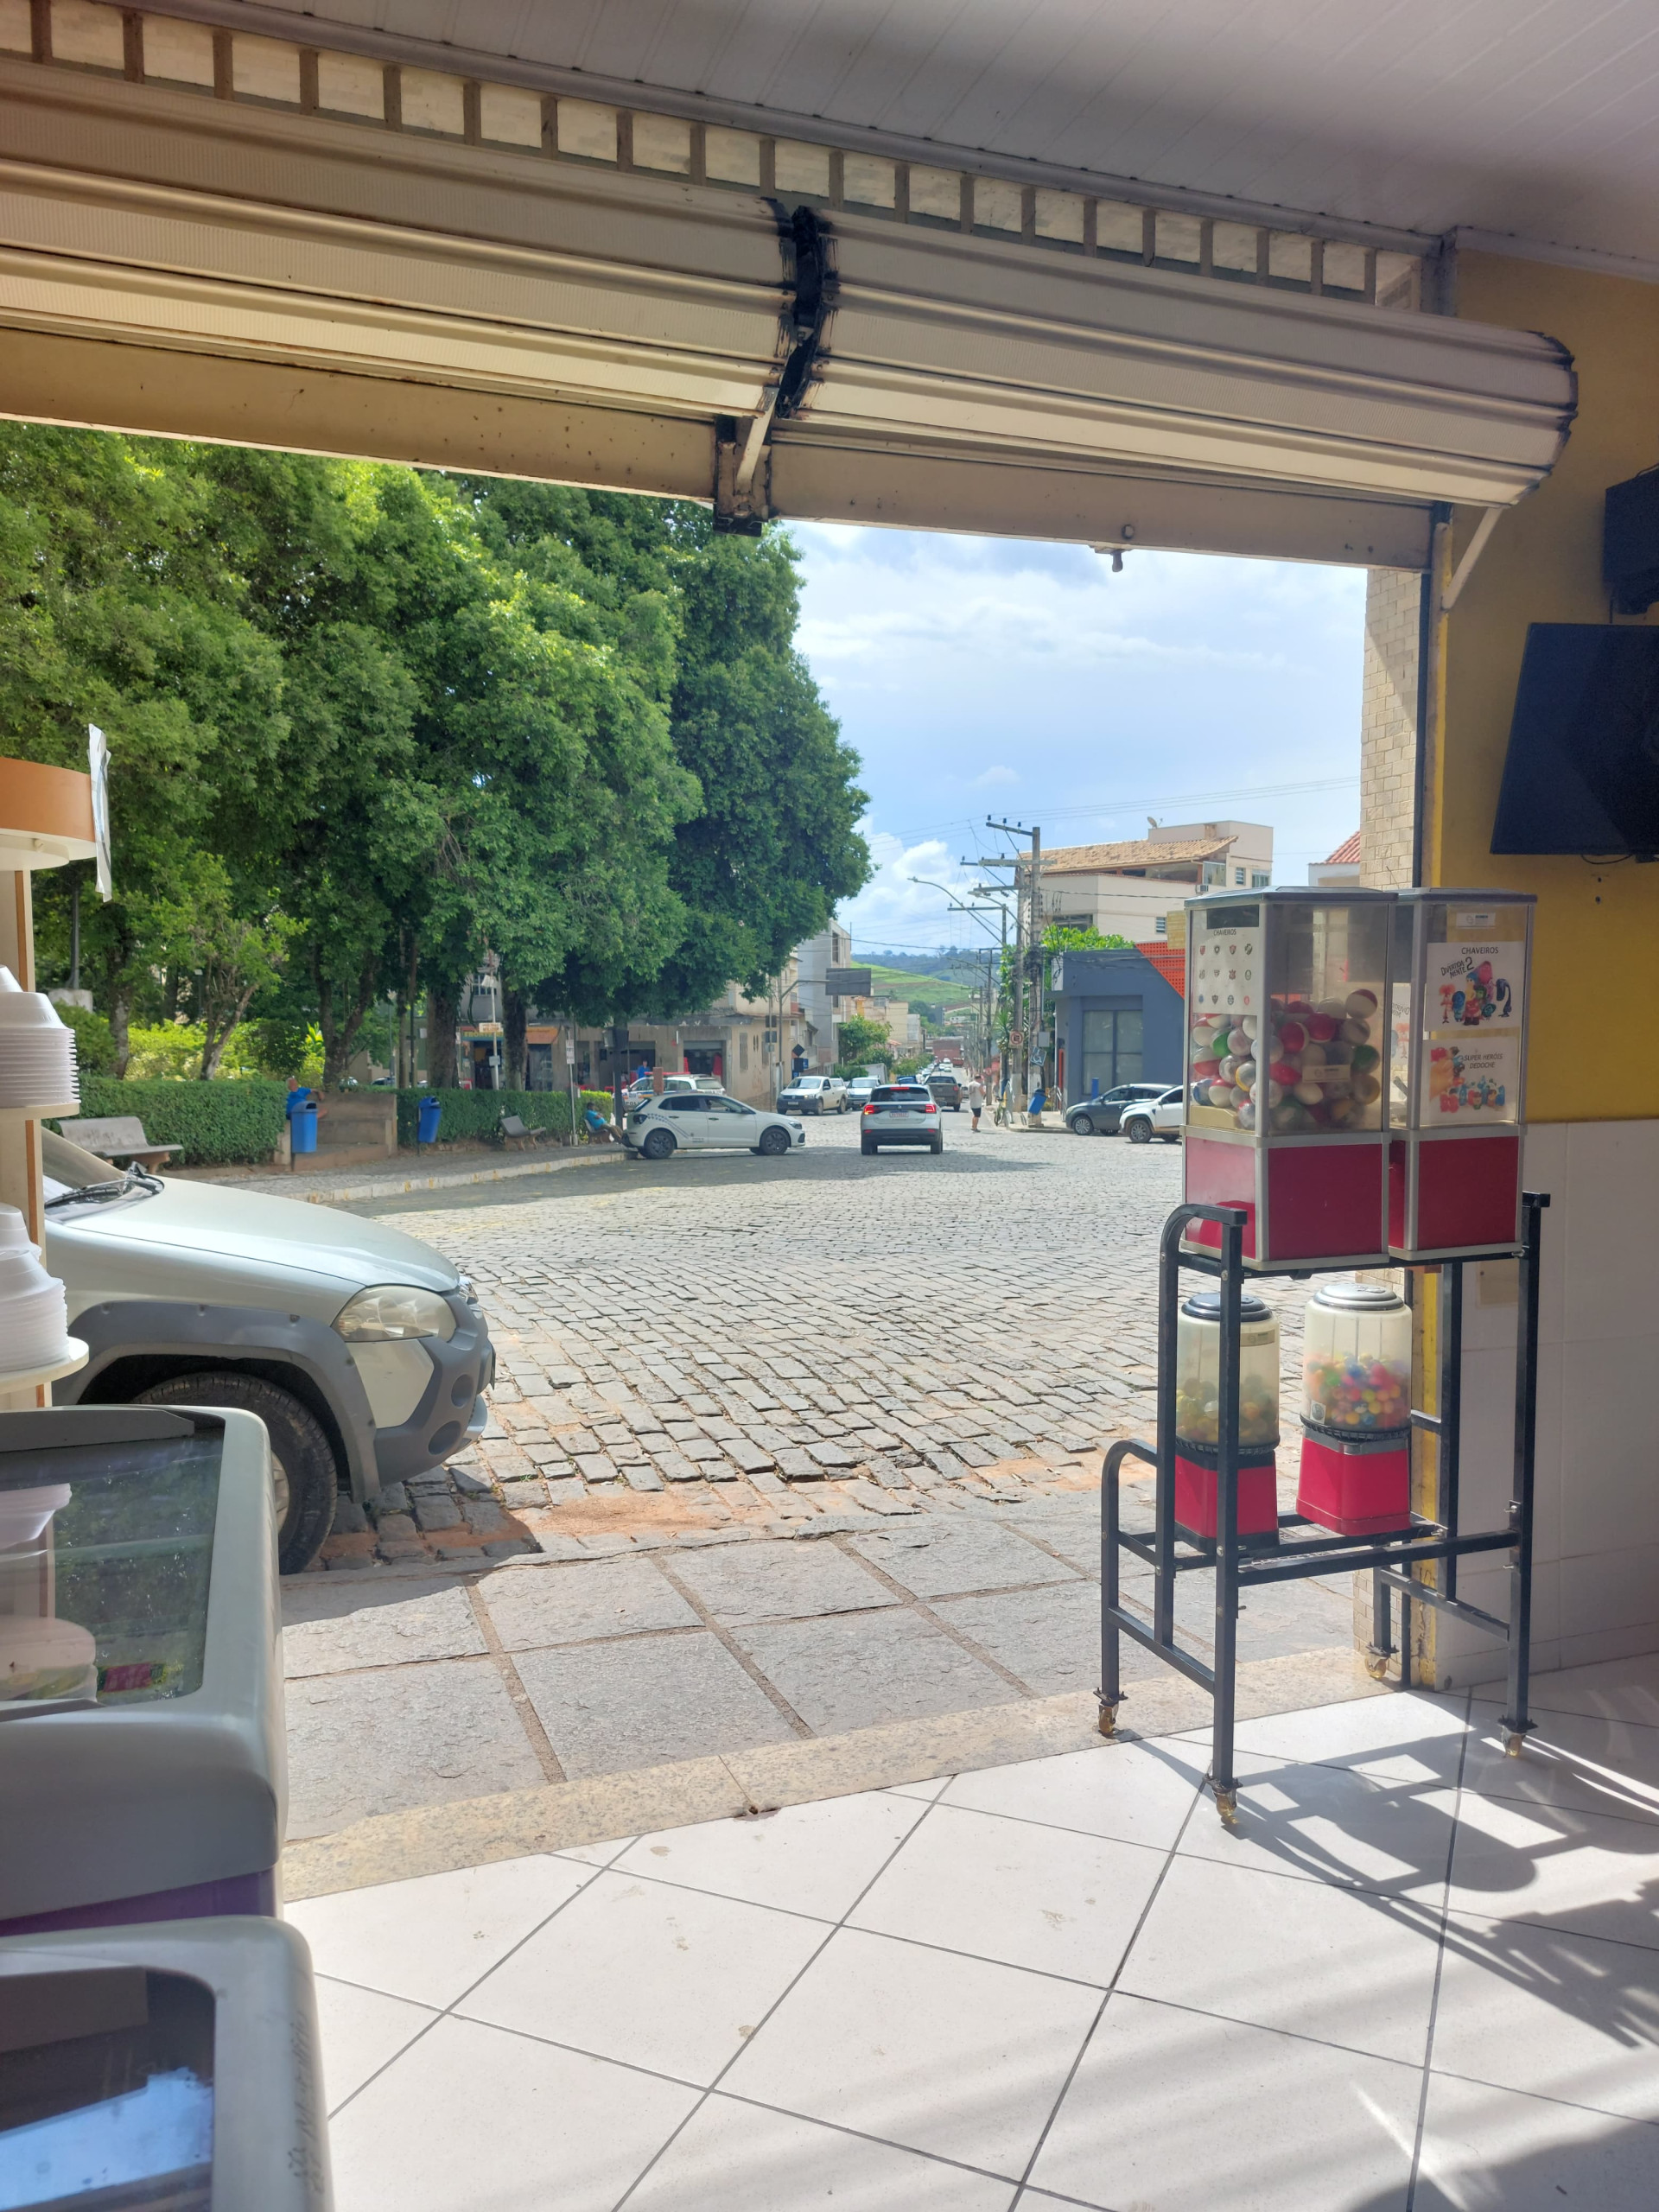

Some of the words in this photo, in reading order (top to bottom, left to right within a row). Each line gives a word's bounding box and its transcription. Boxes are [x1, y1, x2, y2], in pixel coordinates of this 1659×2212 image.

[1461, 946, 1499, 955] CHAVEIROS
[1465, 957, 1474, 971] 2
[1449, 966, 1466, 979] MENTE
